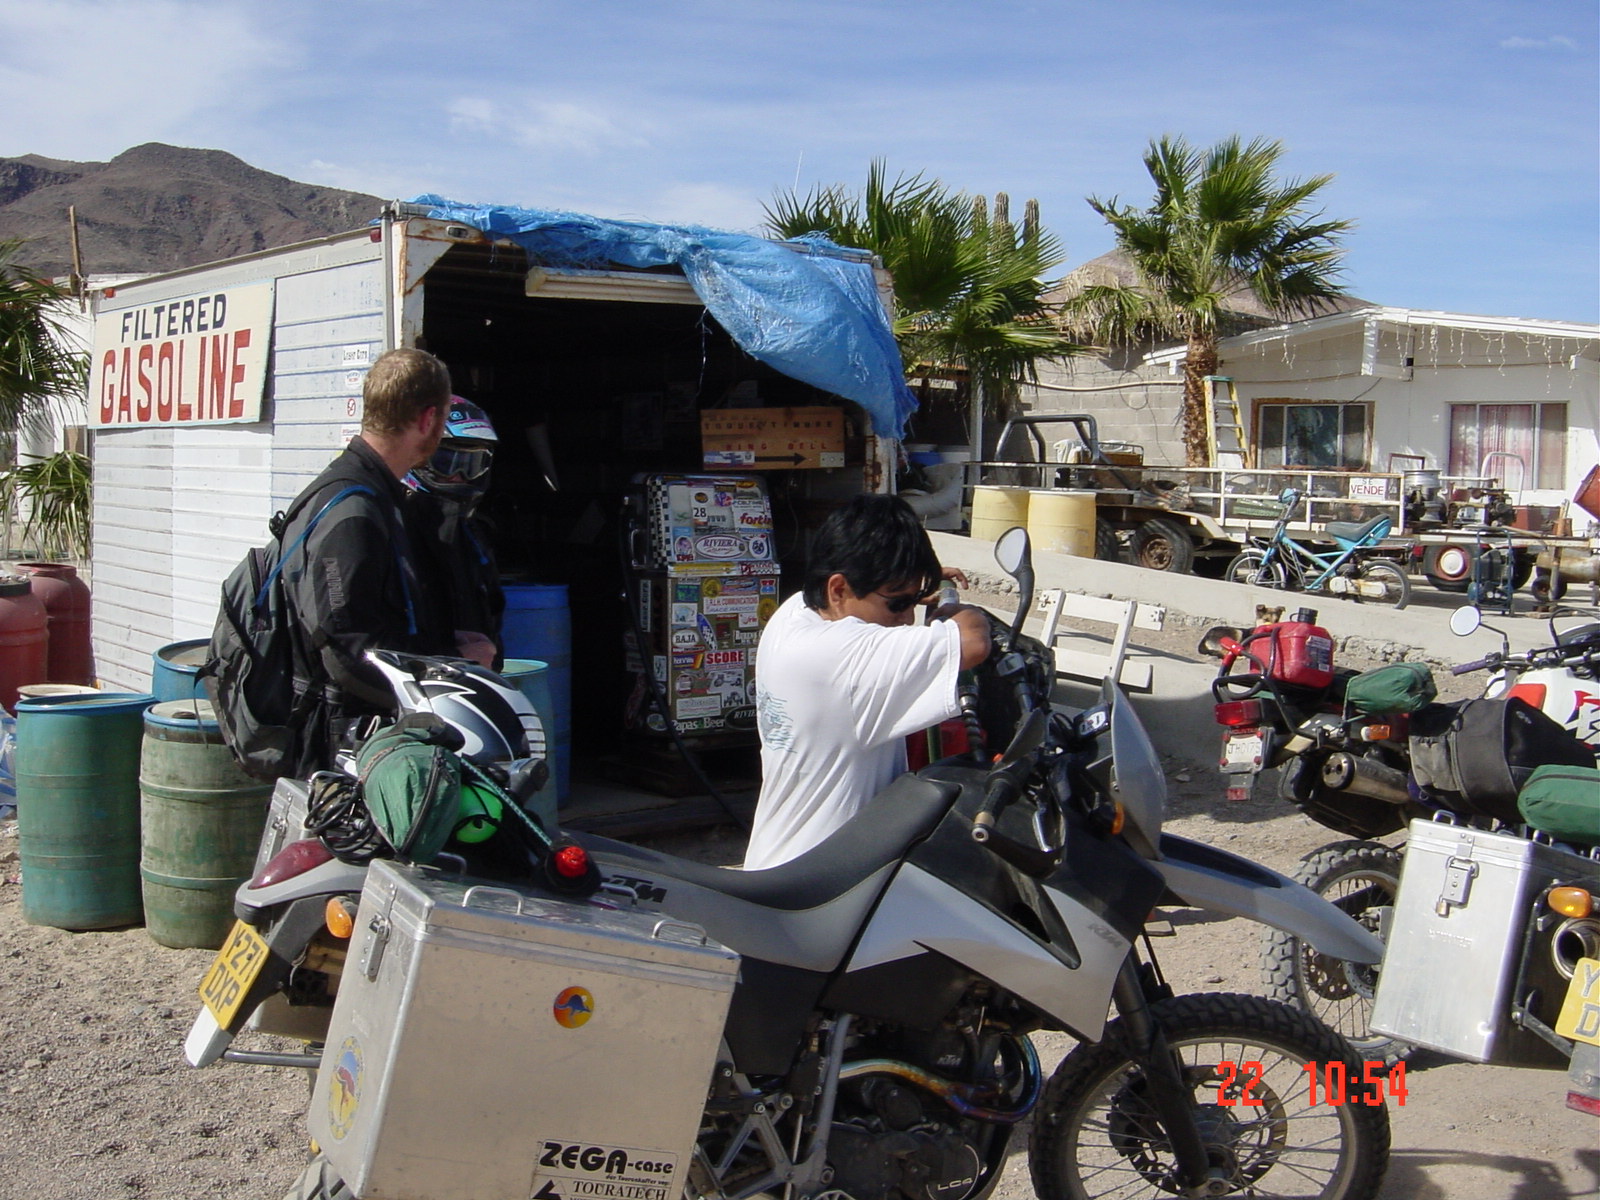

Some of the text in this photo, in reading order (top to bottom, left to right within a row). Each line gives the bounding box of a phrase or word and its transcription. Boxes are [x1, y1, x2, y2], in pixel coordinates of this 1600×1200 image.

[121, 293, 227, 343] FILTERED
[100, 328, 251, 424] GASOLINE
[787, 442, 827, 450] BELL
[1351, 484, 1384, 496] VENDE
[693, 507, 707, 518] 28
[703, 538, 738, 547] RIVIERA
[675, 634, 697, 644] BAJA
[706, 650, 745, 664] SCORE
[703, 717, 726, 728] Beer
[204, 962, 241, 1014] DXP
[572, 1180, 667, 1200] TOURATECH
[937, 1177, 974, 1191] LC4
